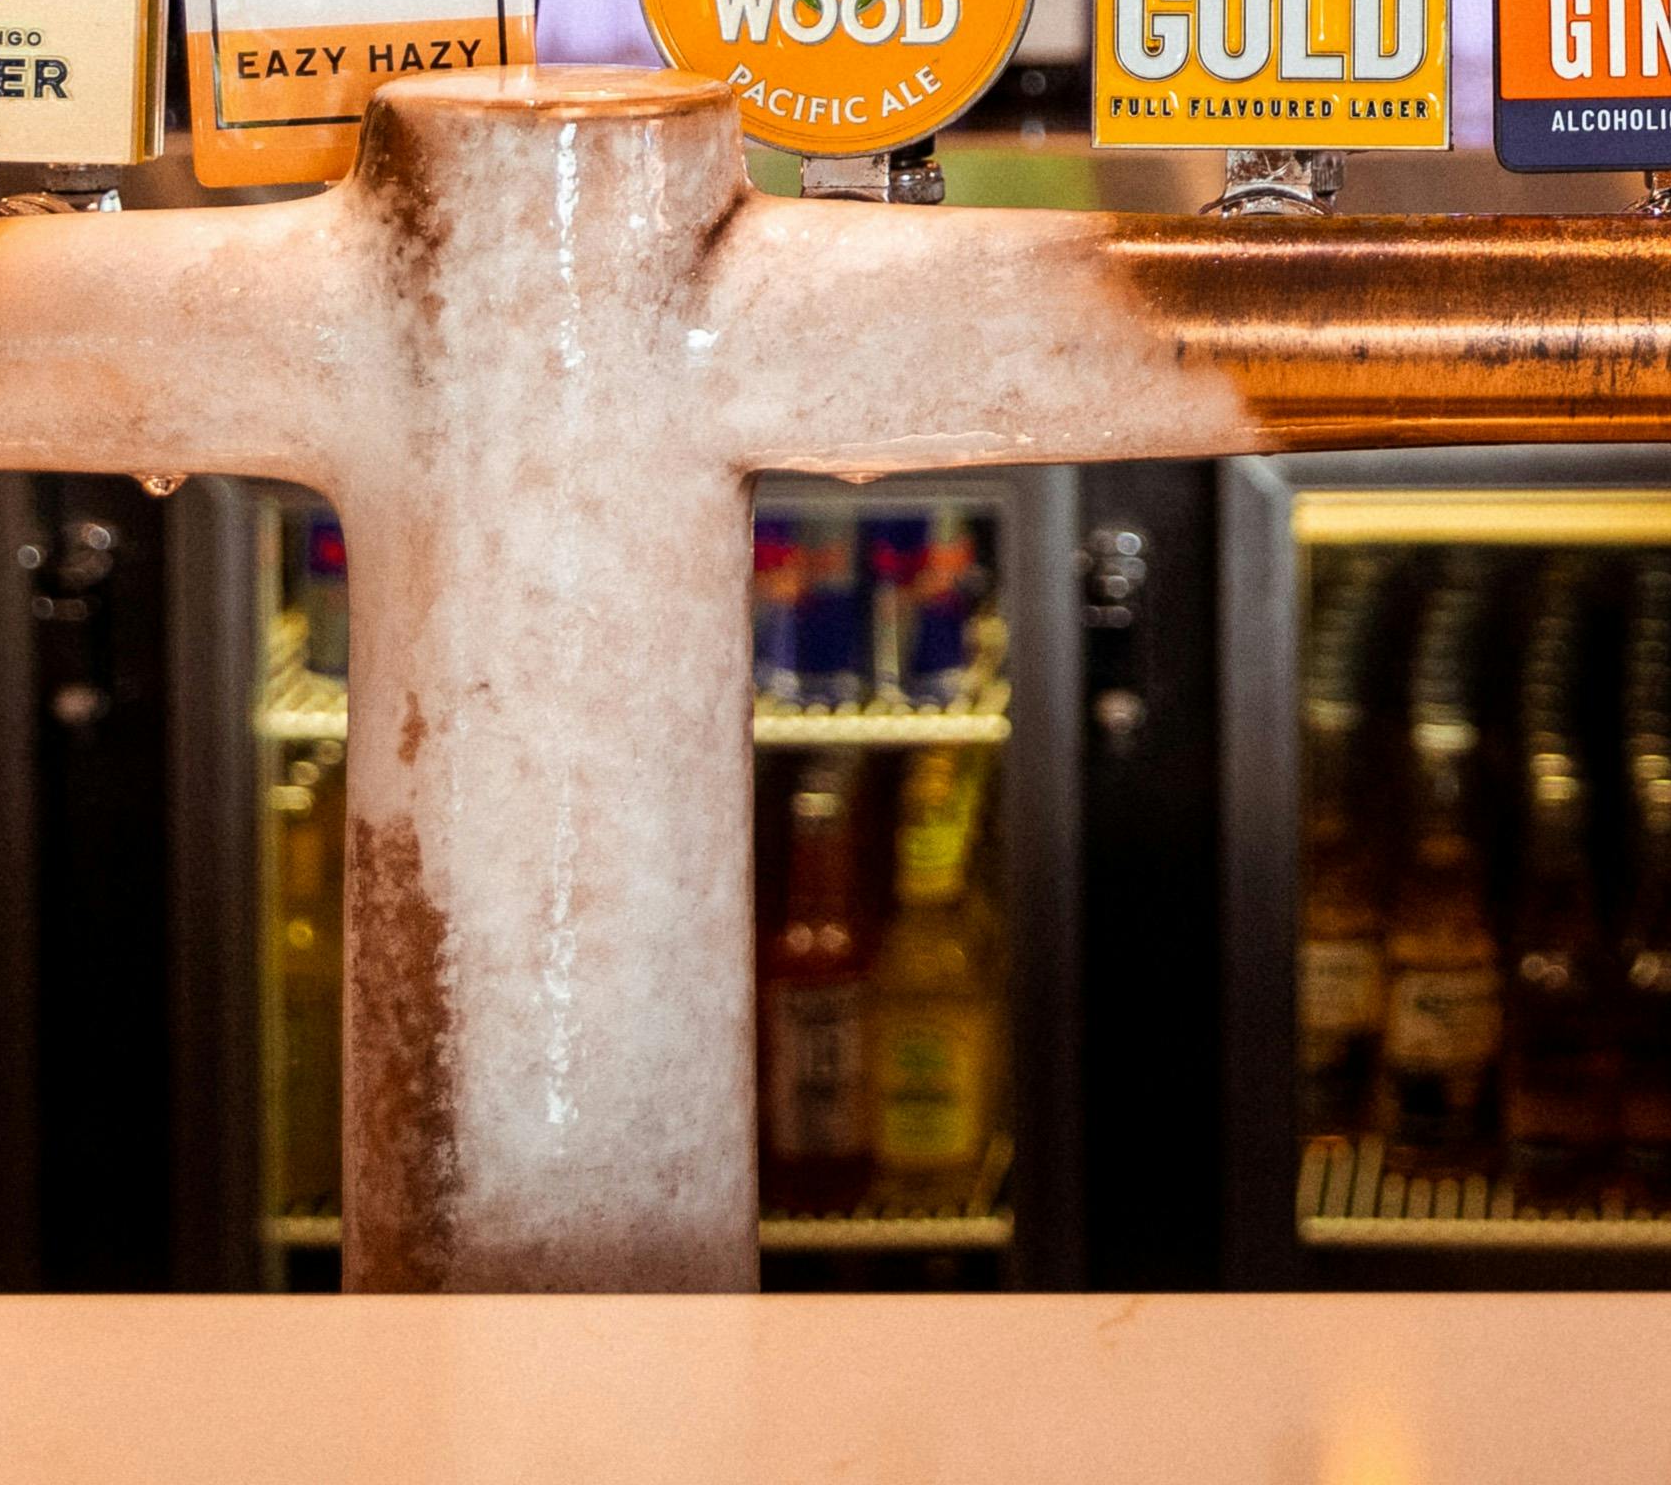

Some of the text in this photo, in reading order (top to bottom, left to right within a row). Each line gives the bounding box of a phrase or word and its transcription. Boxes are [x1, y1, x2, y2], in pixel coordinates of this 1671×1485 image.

[237, 39, 483, 79] EAZY HAZY
[727, 63, 943, 124] PACIFIC ALE
[1111, 98, 1430, 119] FULL FLAVOURED LAGER
